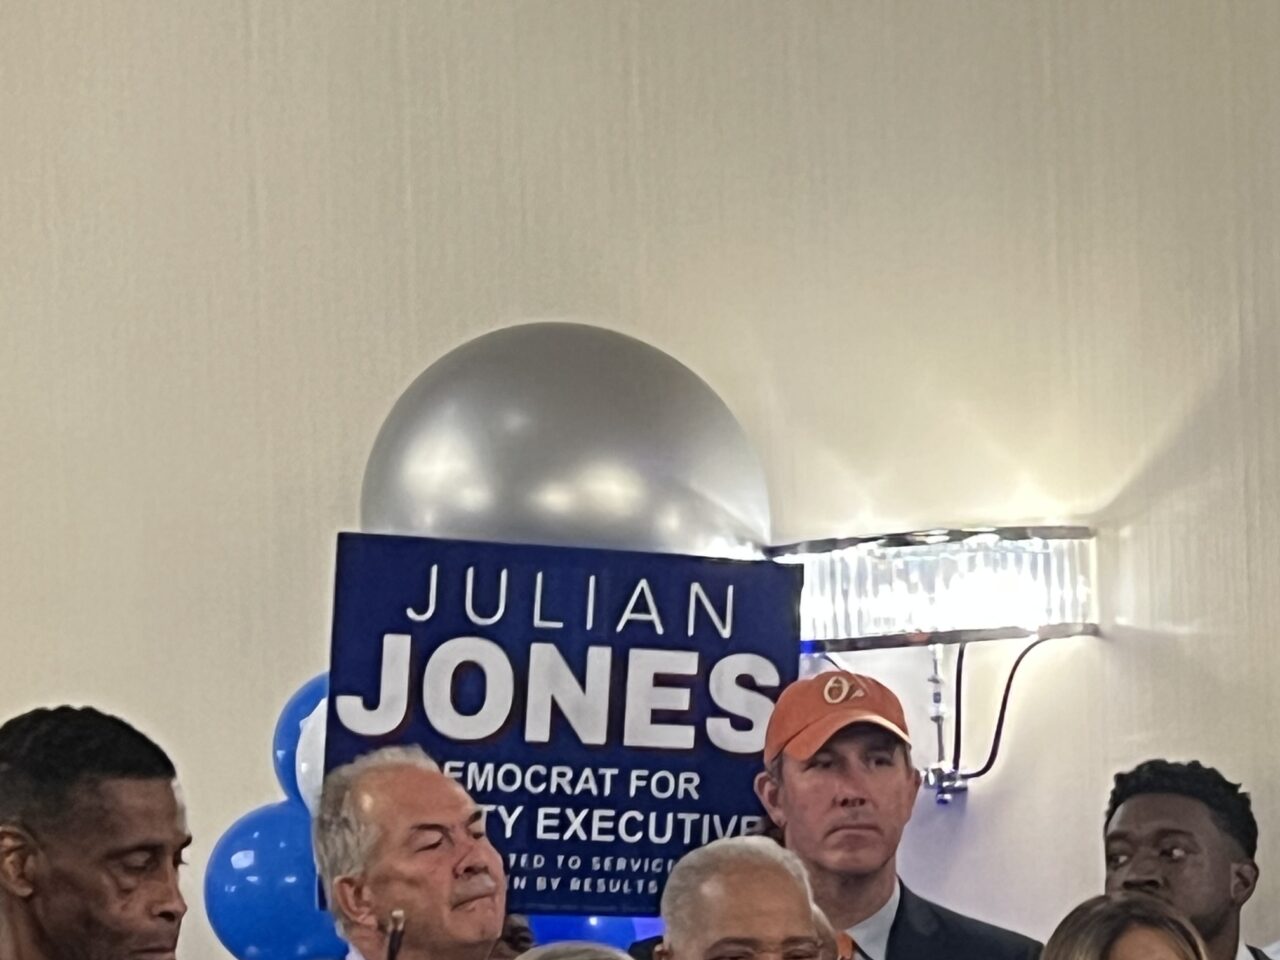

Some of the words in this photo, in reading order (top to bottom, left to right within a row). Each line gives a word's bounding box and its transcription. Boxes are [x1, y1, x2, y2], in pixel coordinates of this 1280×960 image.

[406, 564, 734, 639] JULIAN
[336, 633, 780, 754] JONES
[629, 769, 700, 800] FOR
[557, 854, 582, 870] TO
[536, 876, 561, 892] BY
[569, 877, 658, 894] RESULTS
